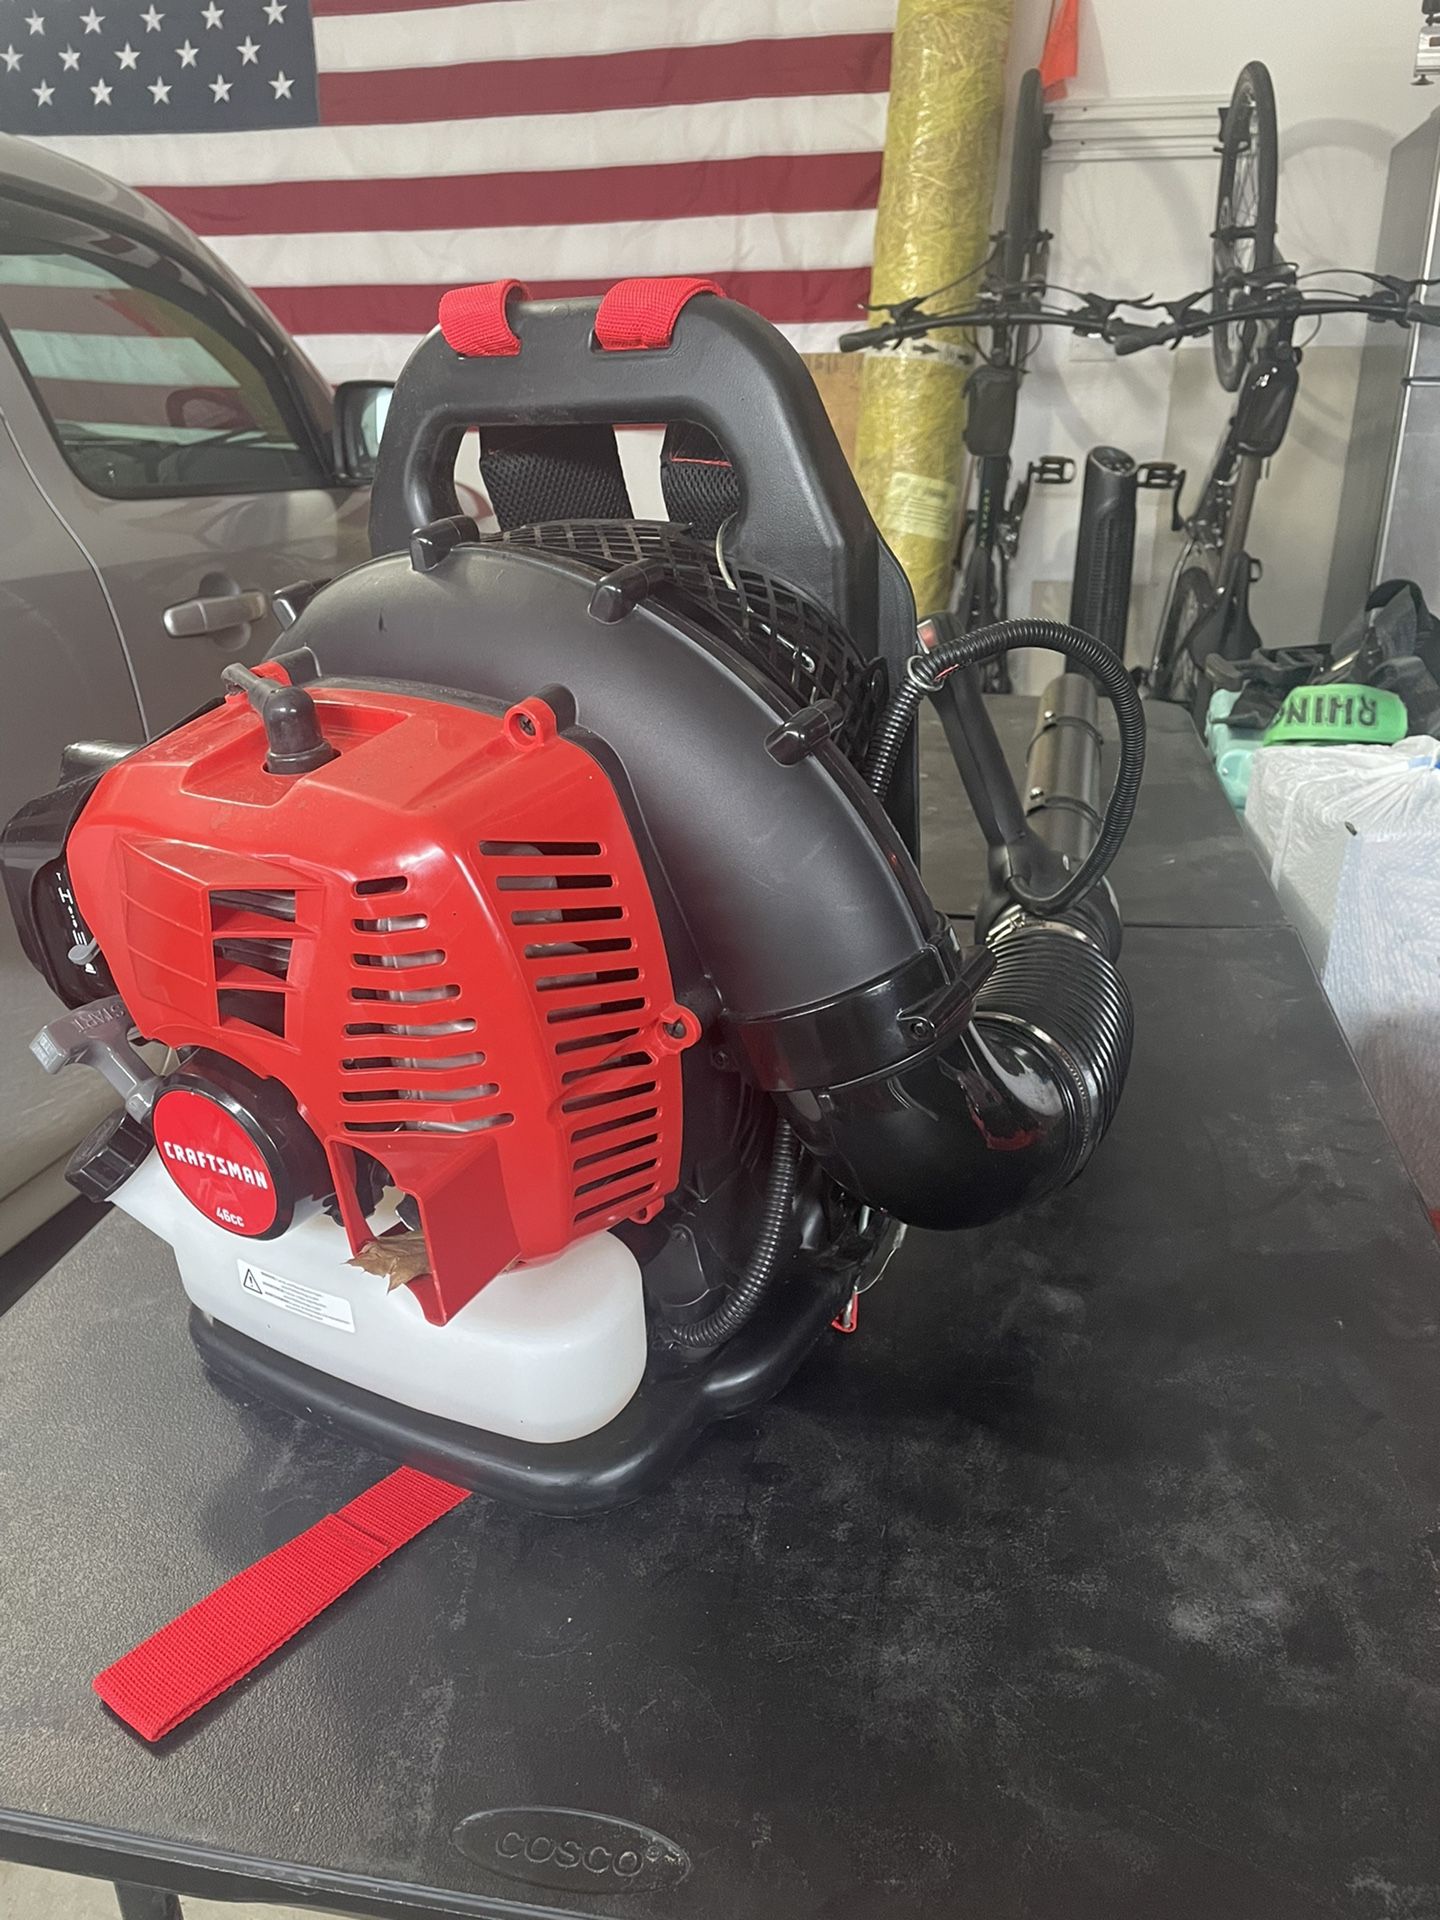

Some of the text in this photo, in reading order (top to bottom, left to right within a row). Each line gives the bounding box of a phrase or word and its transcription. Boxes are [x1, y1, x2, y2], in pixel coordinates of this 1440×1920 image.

[72, 1004, 126, 1033] START
[163, 1140, 269, 1190] CRAFTSMAN
[215, 1206, 245, 1228] 46cc
